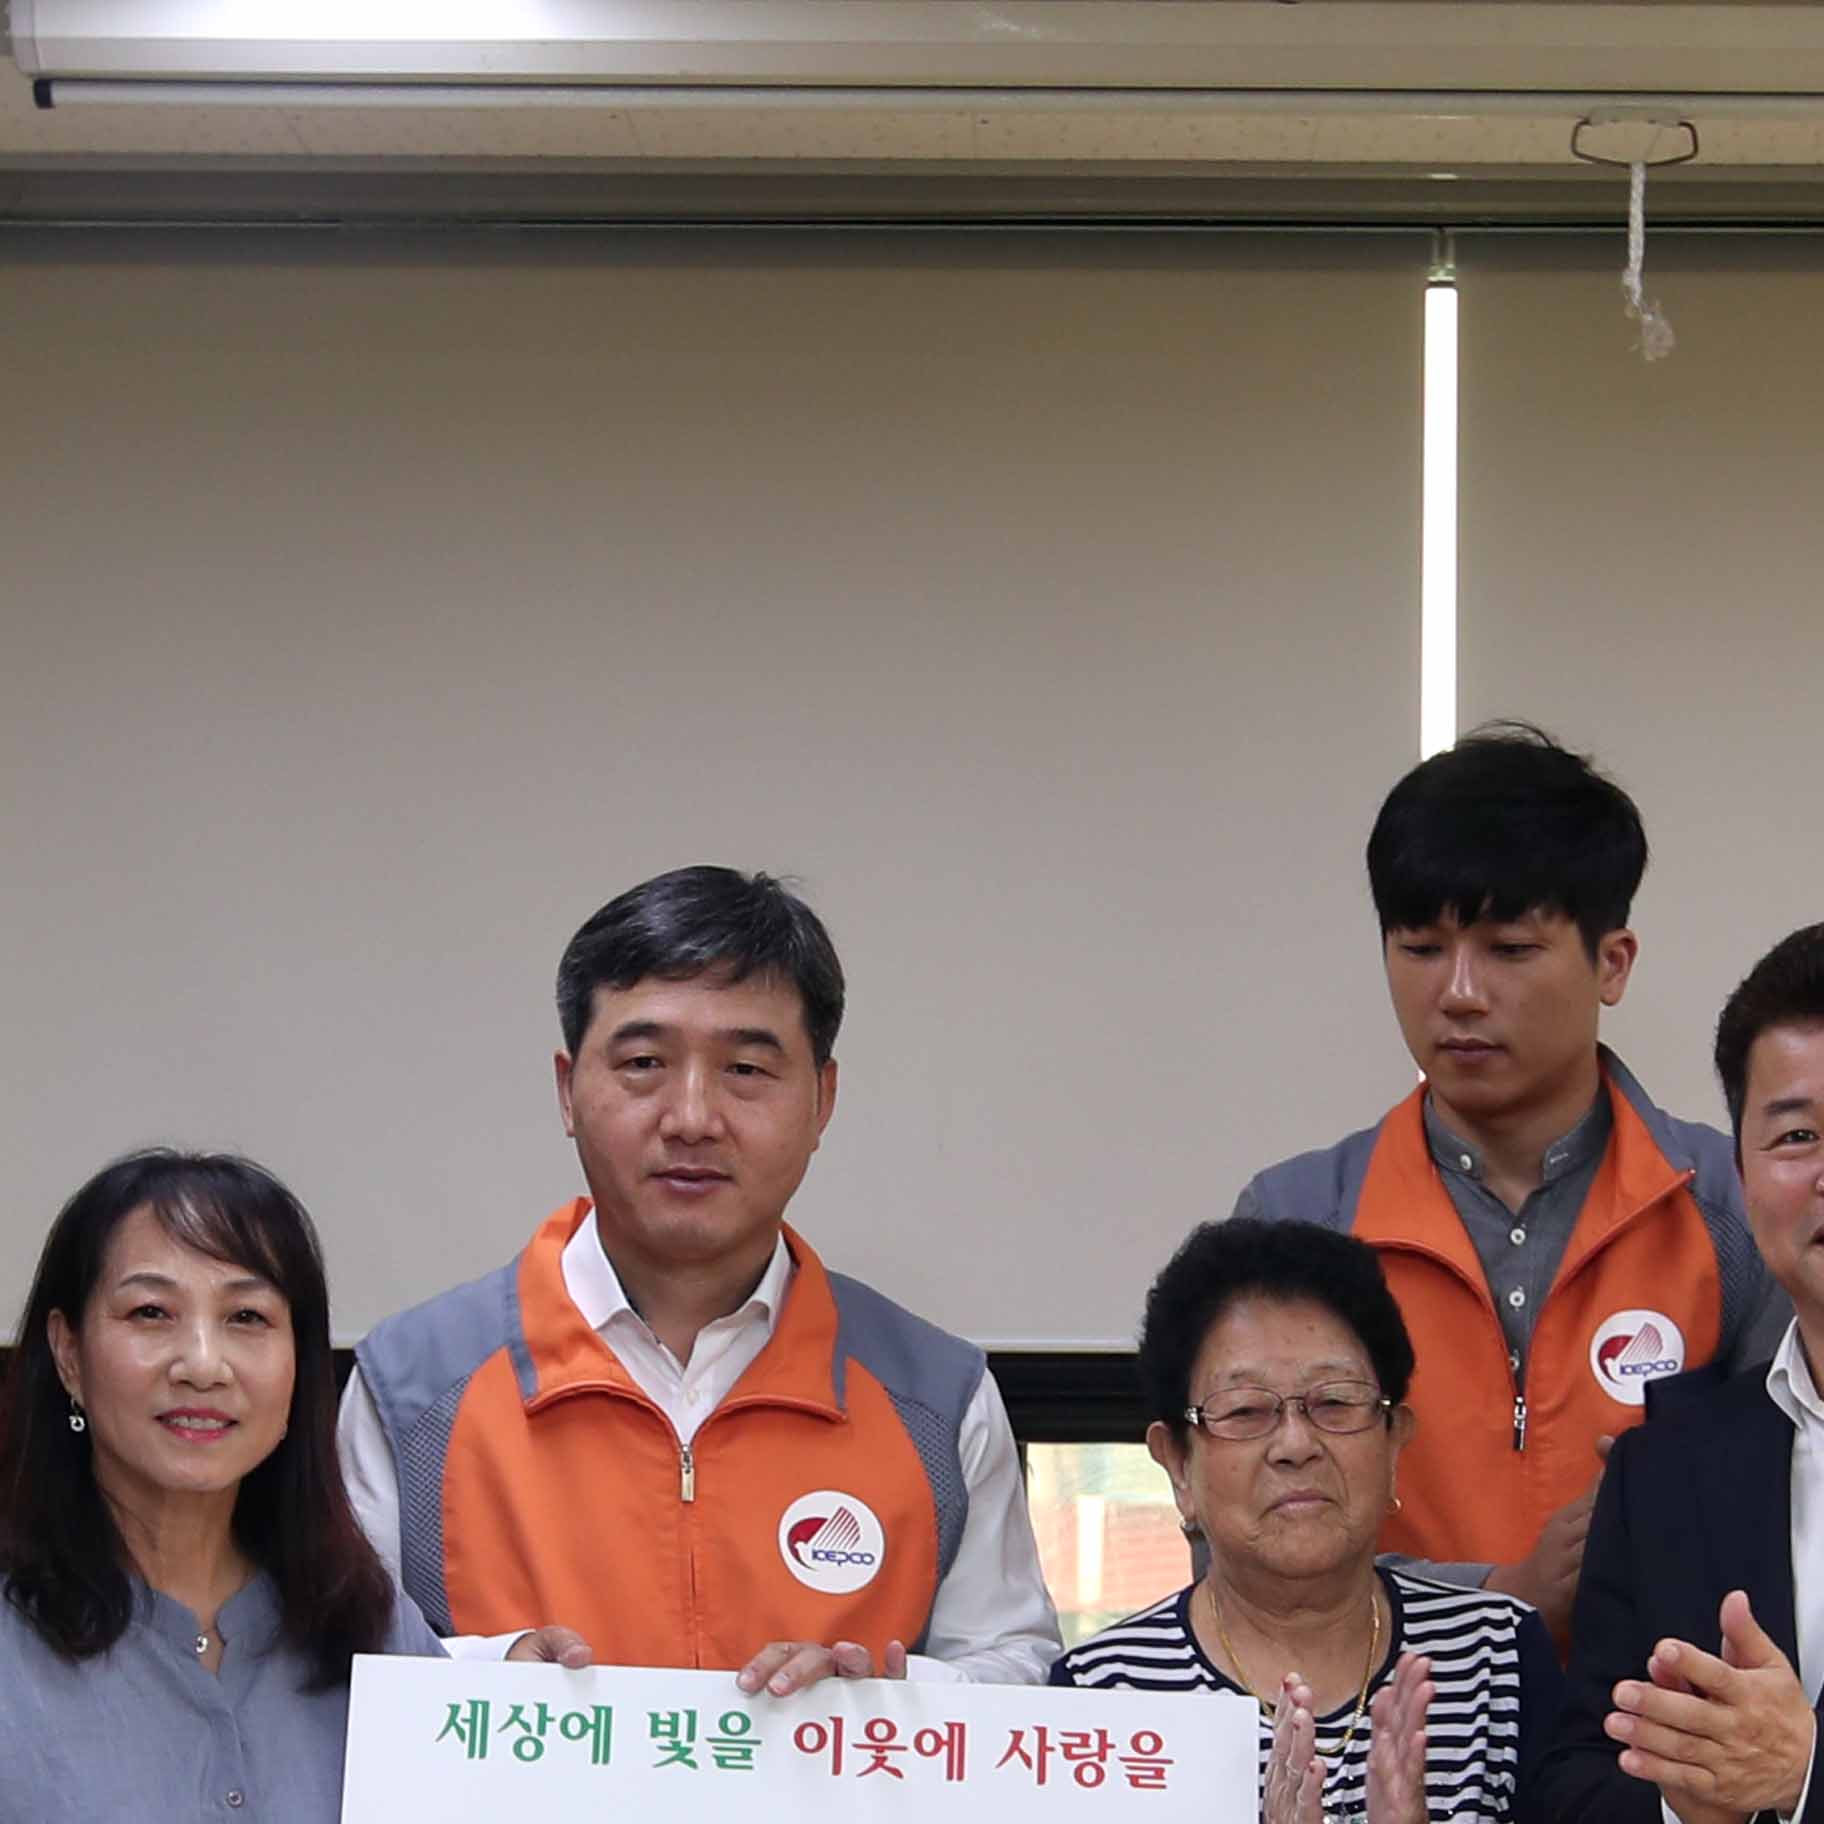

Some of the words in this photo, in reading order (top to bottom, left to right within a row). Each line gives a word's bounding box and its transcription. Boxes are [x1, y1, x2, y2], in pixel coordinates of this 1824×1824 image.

[435, 1699, 613, 1765] 세상에
[646, 1709, 763, 1770] 빛을
[793, 1715, 966, 1781] 이웃에
[994, 1725, 1174, 1790] 사랑을
